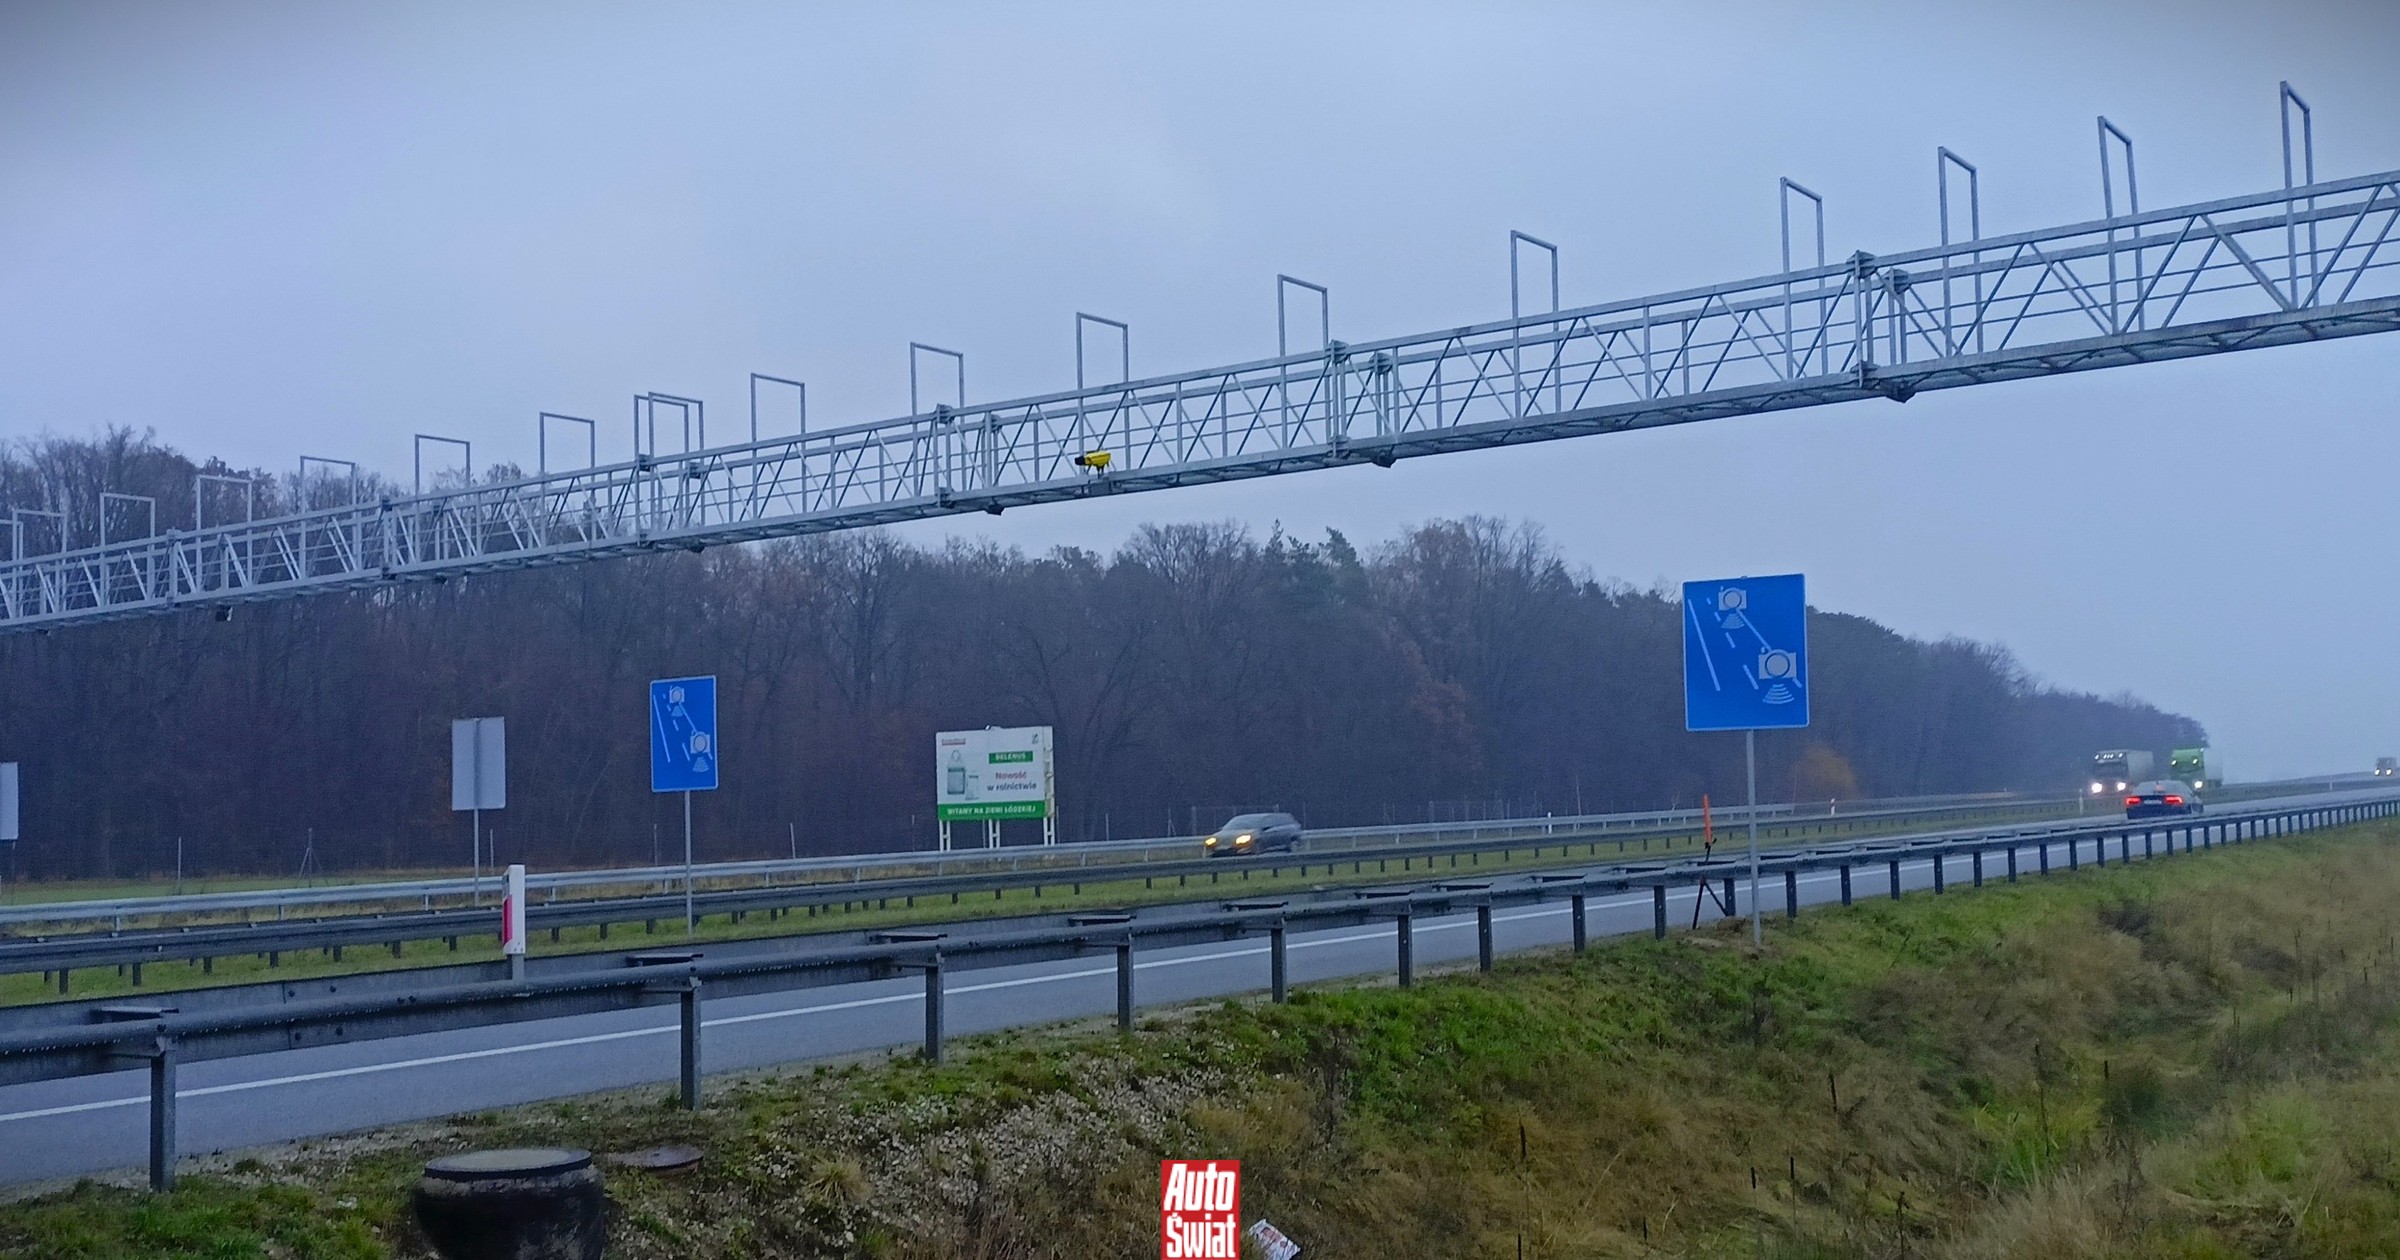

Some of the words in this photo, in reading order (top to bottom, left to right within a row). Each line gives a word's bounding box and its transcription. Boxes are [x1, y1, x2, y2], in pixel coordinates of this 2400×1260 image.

[996, 781, 1037, 791] rolnictwie
[947, 808, 973, 816] WITAMY
[974, 807, 984, 815] NA
[985, 806, 1003, 815] ZIEMI
